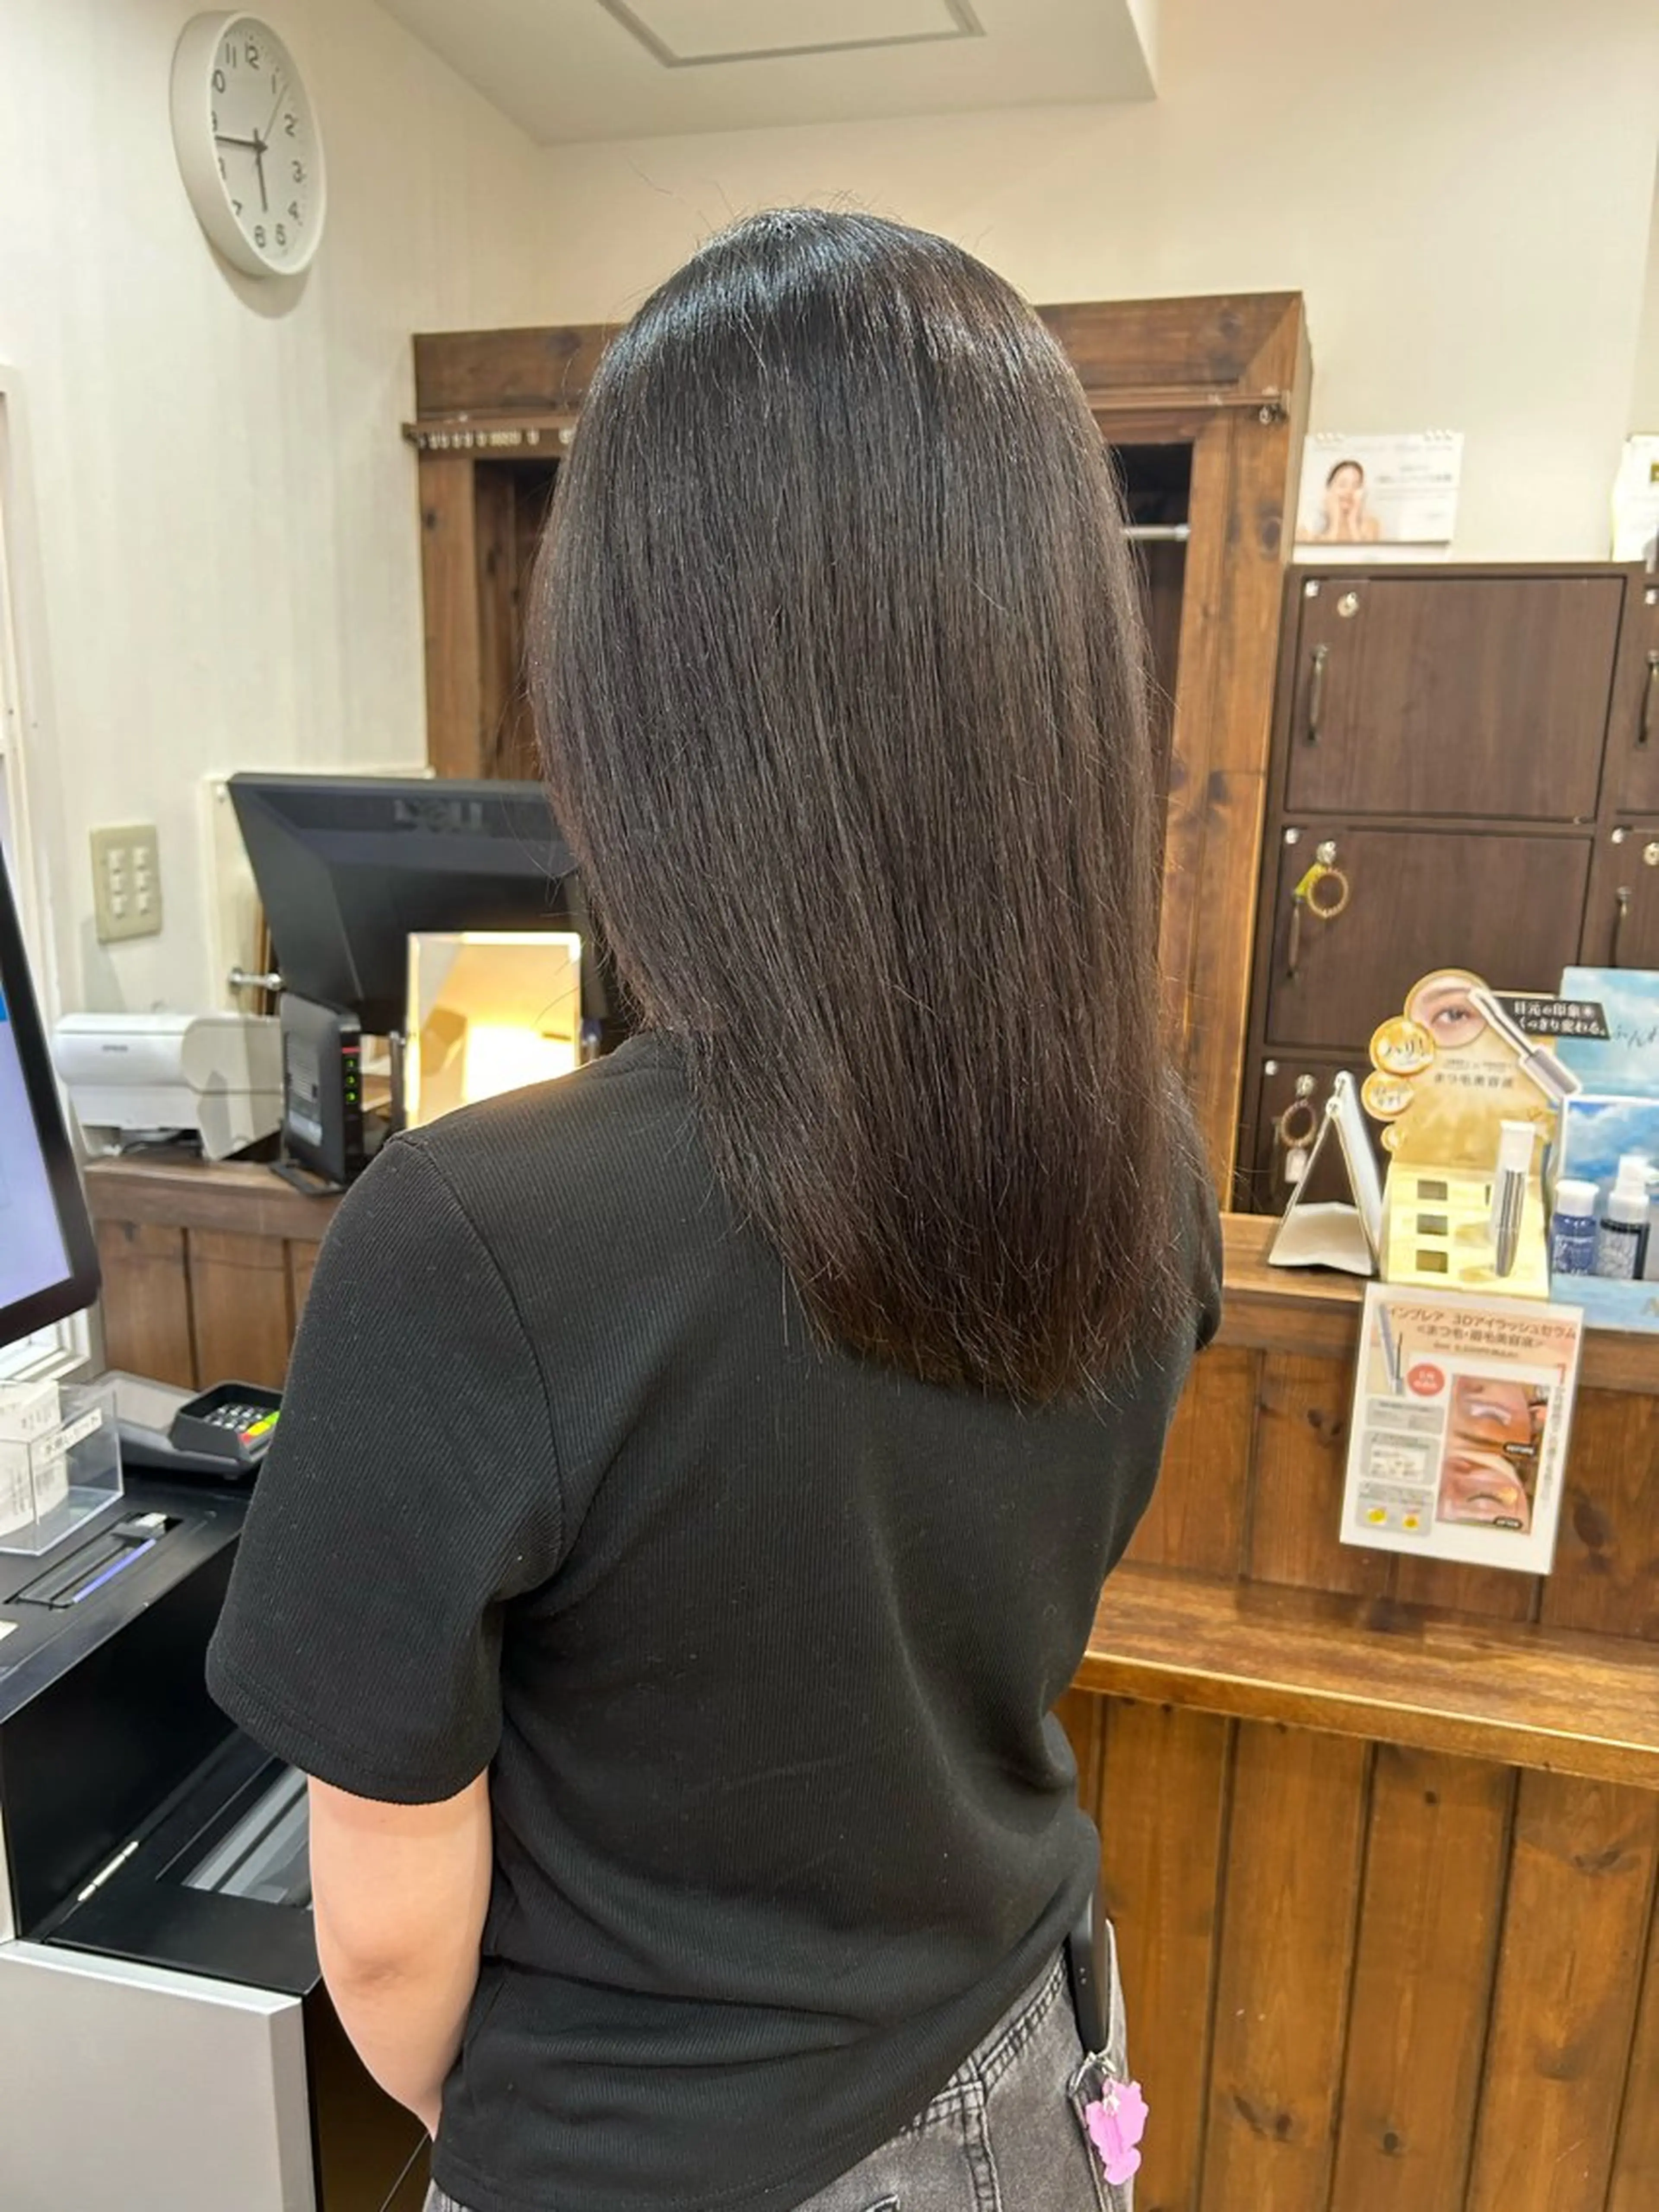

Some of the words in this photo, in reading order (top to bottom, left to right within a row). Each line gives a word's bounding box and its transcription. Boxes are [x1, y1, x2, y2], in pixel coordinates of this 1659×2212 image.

[226, 42, 237, 69] 11
[245, 41, 260, 70] 12
[212, 69, 226, 94] 0
[271, 74, 276, 95] 1
[283, 114, 296, 138] 2
[291, 159, 302, 183] 3
[287, 200, 299, 220] 4
